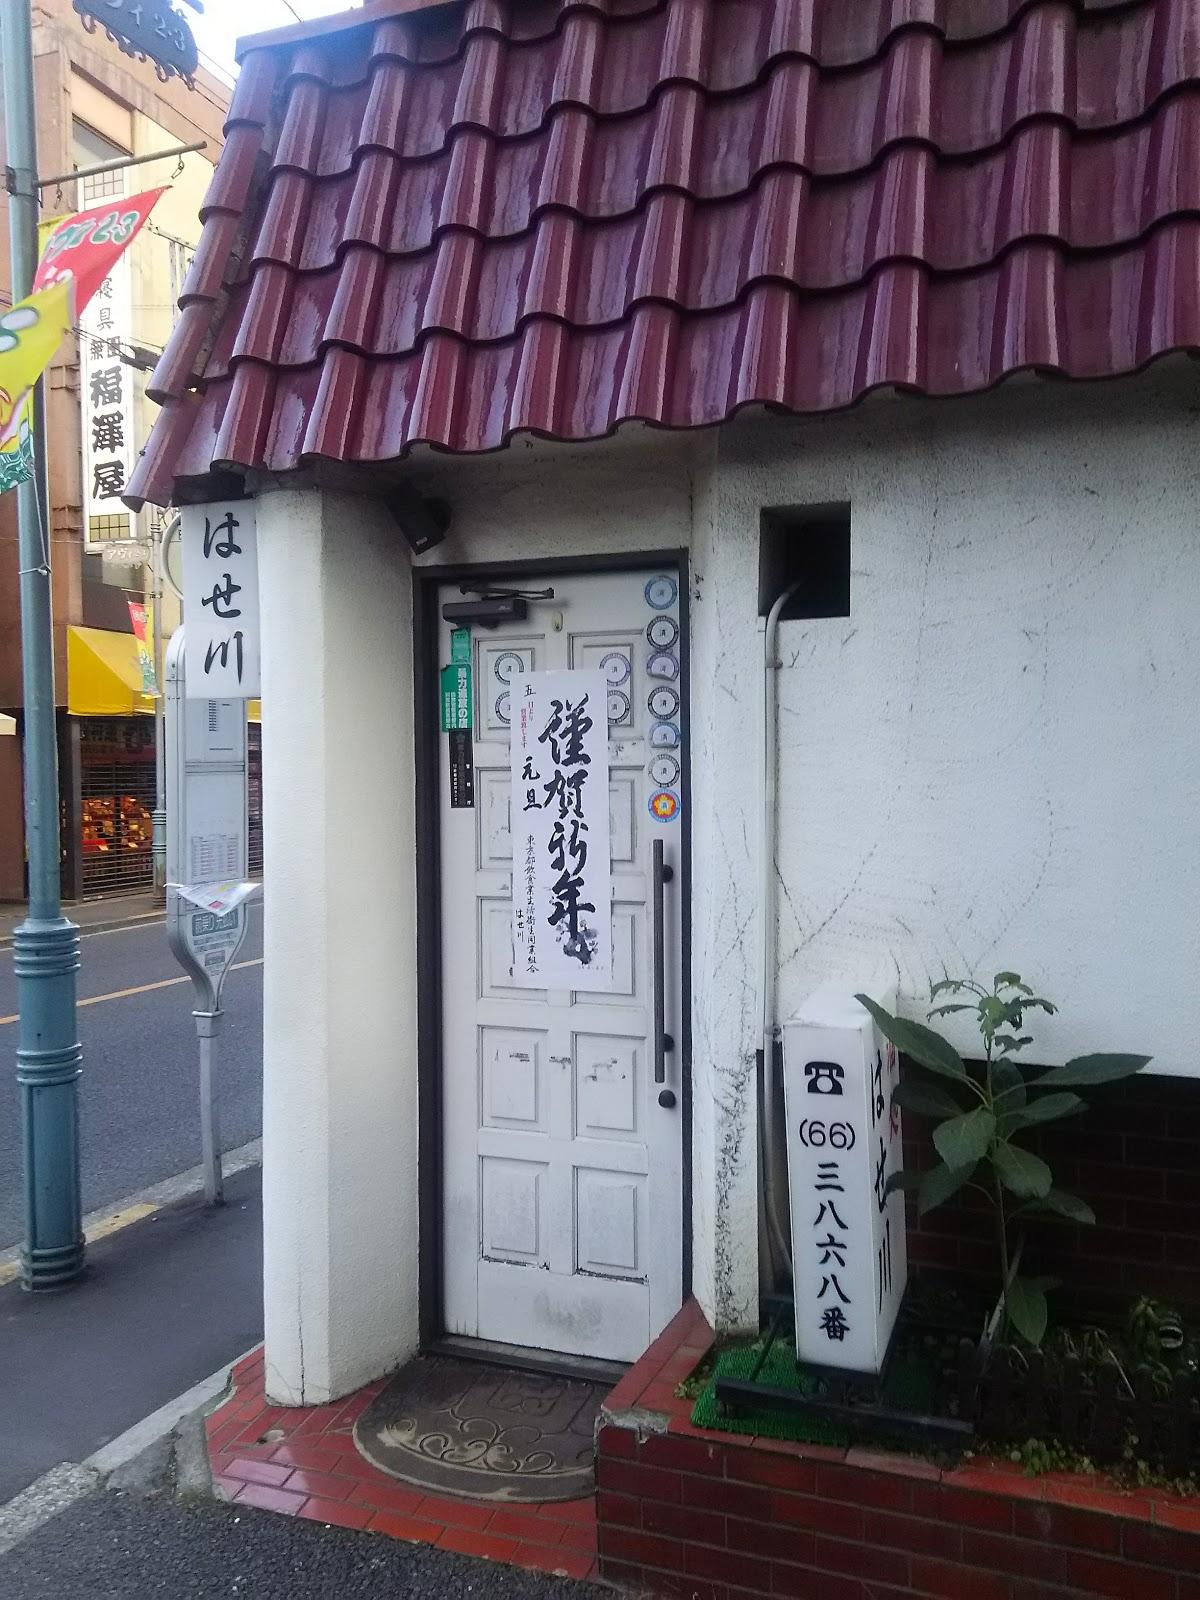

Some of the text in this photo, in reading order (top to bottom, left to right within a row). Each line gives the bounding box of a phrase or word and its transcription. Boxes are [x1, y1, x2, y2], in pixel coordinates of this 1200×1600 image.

[201, 512, 243, 686] はせ川
[522, 755, 542, 812] 元旦
[538, 692, 597, 942] 謹賀新年
[515, 909, 525, 943] はせ川
[799, 1118, 856, 1342] (66) 三八六八番
